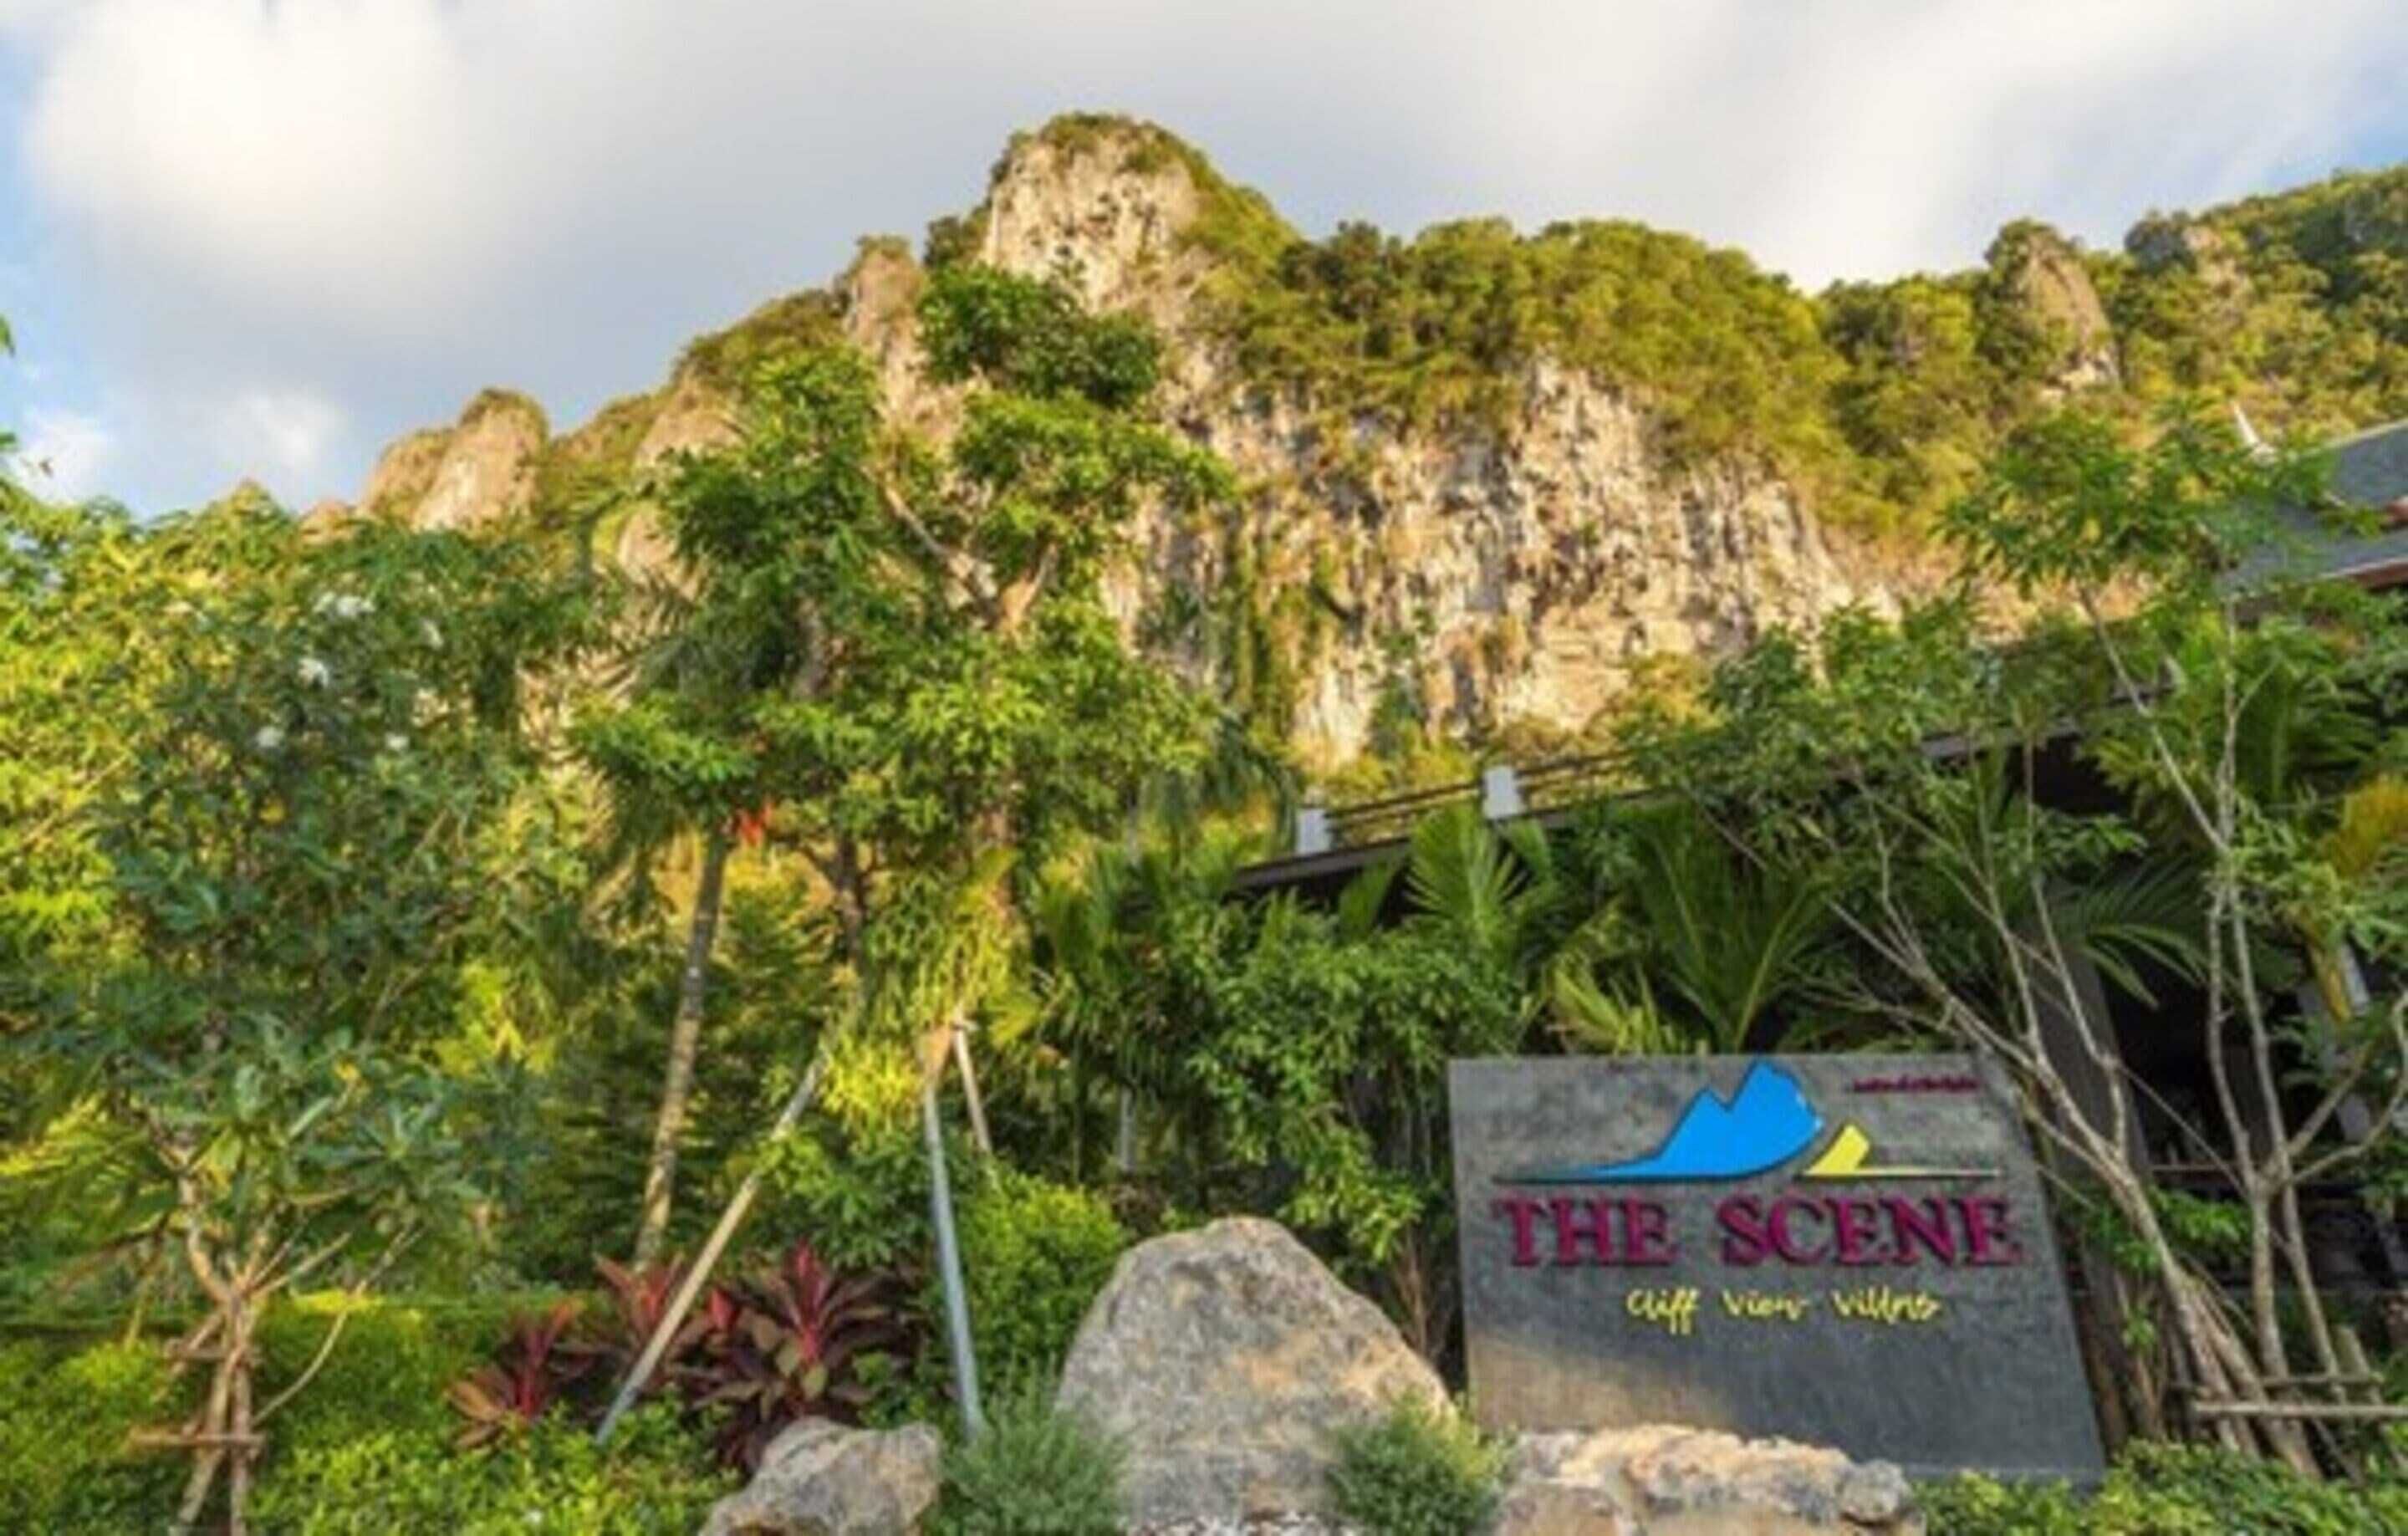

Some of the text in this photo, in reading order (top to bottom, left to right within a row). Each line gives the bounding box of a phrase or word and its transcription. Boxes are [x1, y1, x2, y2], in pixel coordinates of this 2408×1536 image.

[1492, 1194, 2023, 1267] THE SCENE
[1625, 1286, 1698, 1334] Cliff
[1722, 1288, 1810, 1319] View
